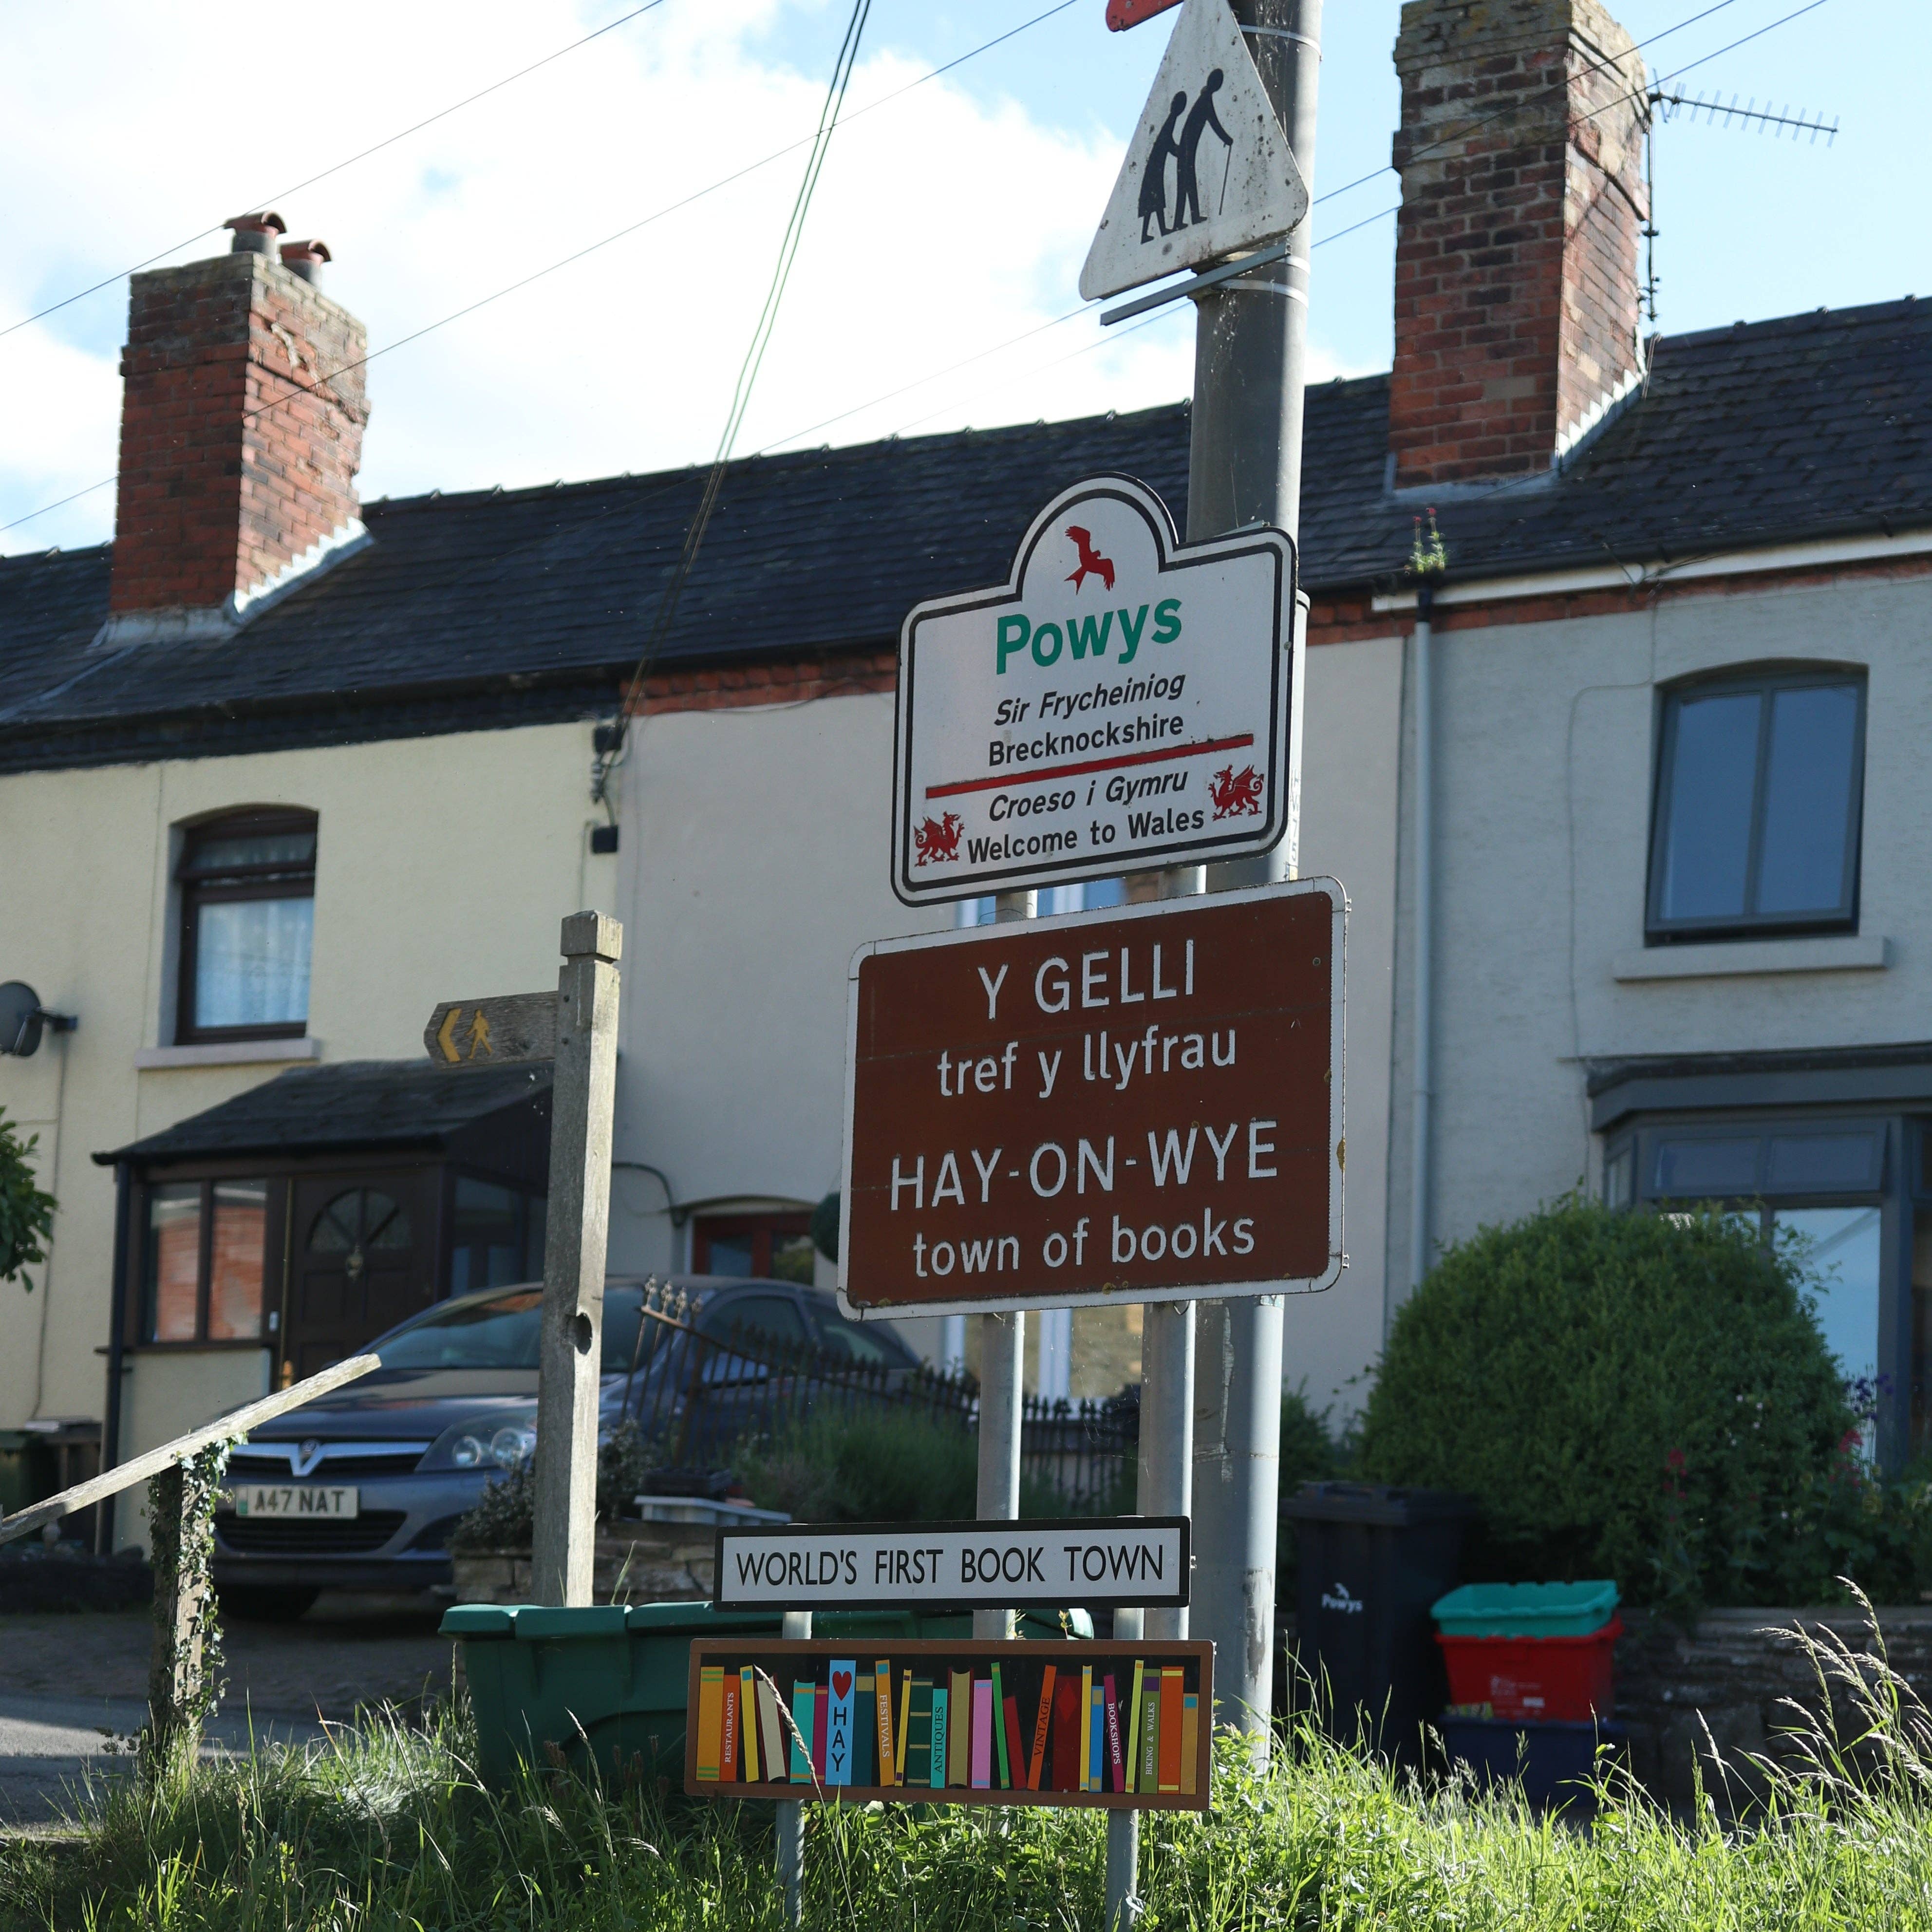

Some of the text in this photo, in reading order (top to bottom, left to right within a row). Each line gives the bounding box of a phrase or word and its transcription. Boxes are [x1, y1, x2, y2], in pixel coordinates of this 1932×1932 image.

[997, 599, 1181, 675] Powys
[994, 674, 1185, 726] Sir Frycheiniog
[990, 713, 1183, 766] Brecknockshire
[990, 771, 1188, 821] Croeso i Gymru
[968, 808, 1204, 863] Welcome to Wales
[978, 939, 1193, 1019] Y GELLI
[938, 1025, 1235, 1098] tref y llyfrau
[891, 1121, 1277, 1210] HAY-ON-WYE
[913, 1208, 1254, 1276] town of books
[255, 1489, 344, 1512] A47 NAT
[736, 1545, 1163, 1586] WORLD'S FIRST BOOK TOWN
[1322, 1593, 1364, 1614] Powys
[724, 1692, 734, 1763] RESTAURANTS
[832, 1707, 847, 1772] HAY
[880, 1694, 890, 1758] FESTIVALS
[934, 1706, 944, 1774] ANTIQUES
[1033, 1697, 1051, 1757] VINTAGE
[1107, 1702, 1121, 1765] BOOKSHOPS
[1147, 1702, 1155, 1731] WALKS
[1145, 1746, 1154, 1775] BIKING
